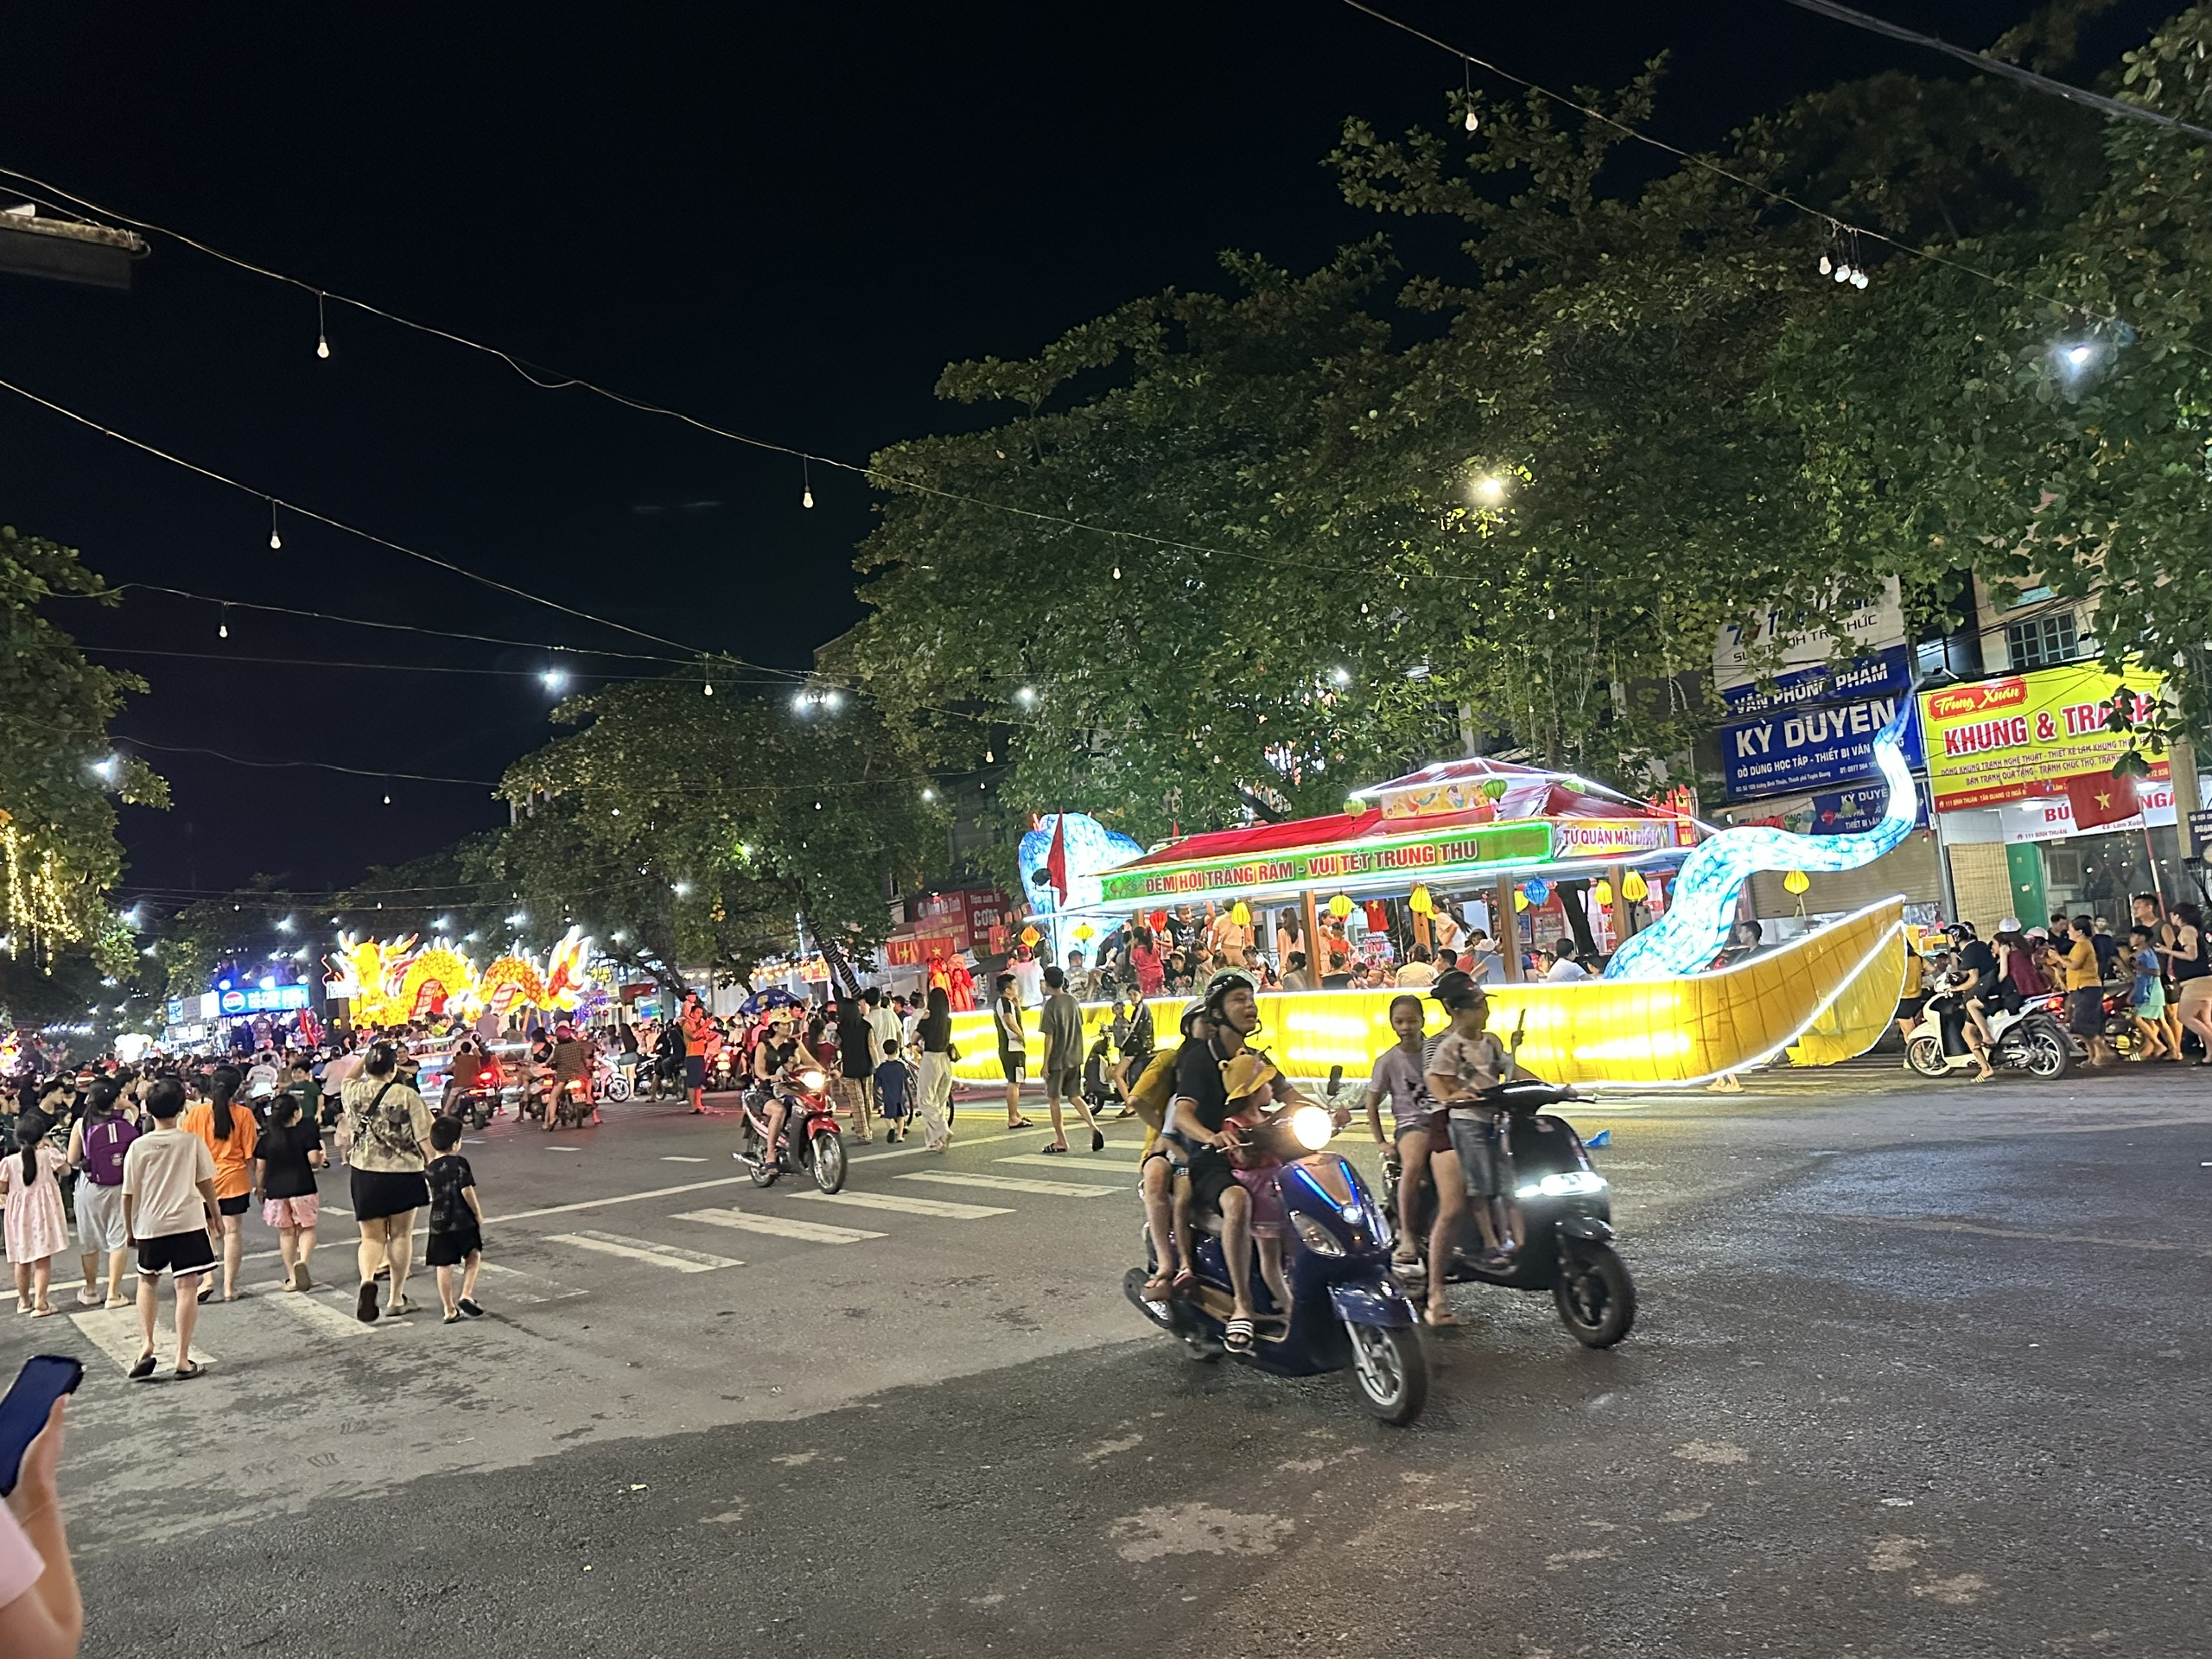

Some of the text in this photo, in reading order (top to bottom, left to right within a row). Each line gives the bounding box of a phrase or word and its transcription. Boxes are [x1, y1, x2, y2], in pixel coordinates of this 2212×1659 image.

[1773, 678, 1828, 705] PHÒN
[1835, 659, 1888, 690] PHẨM
[1934, 683, 2019, 716] Trung Xuân
[1735, 717, 1773, 758] KỲ
[1943, 717, 2028, 755] KHUNG
[2037, 712, 2056, 739] &
[1737, 764, 1748, 779] ĐỒ
[1750, 762, 1773, 776] DÙNG
[1774, 759, 1791, 773] HỌC
[1792, 753, 1808, 769] TẬP
[1815, 746, 1839, 763] THIẾT
[1840, 747, 1851, 760] BỊ
[1852, 742, 1872, 757] VĂN
[1981, 760, 2003, 770] TRANH
[2093, 740, 2117, 752] KHUNG
[1858, 785, 1889, 802] DUYÊ
[2044, 802, 2074, 823] BÚ
[1563, 824, 1580, 845] TỨ
[1614, 826, 1634, 845] MÃI
[1146, 873, 1175, 894] ĐÊM
[1179, 869, 1204, 893] HỘI
[1205, 866, 1254, 887] TRĂNG
[1308, 853, 1337, 877] VUI
[1340, 848, 1370, 873] TẾT
[1373, 844, 1435, 869] TRUNG
[1439, 839, 1478, 862] THU
